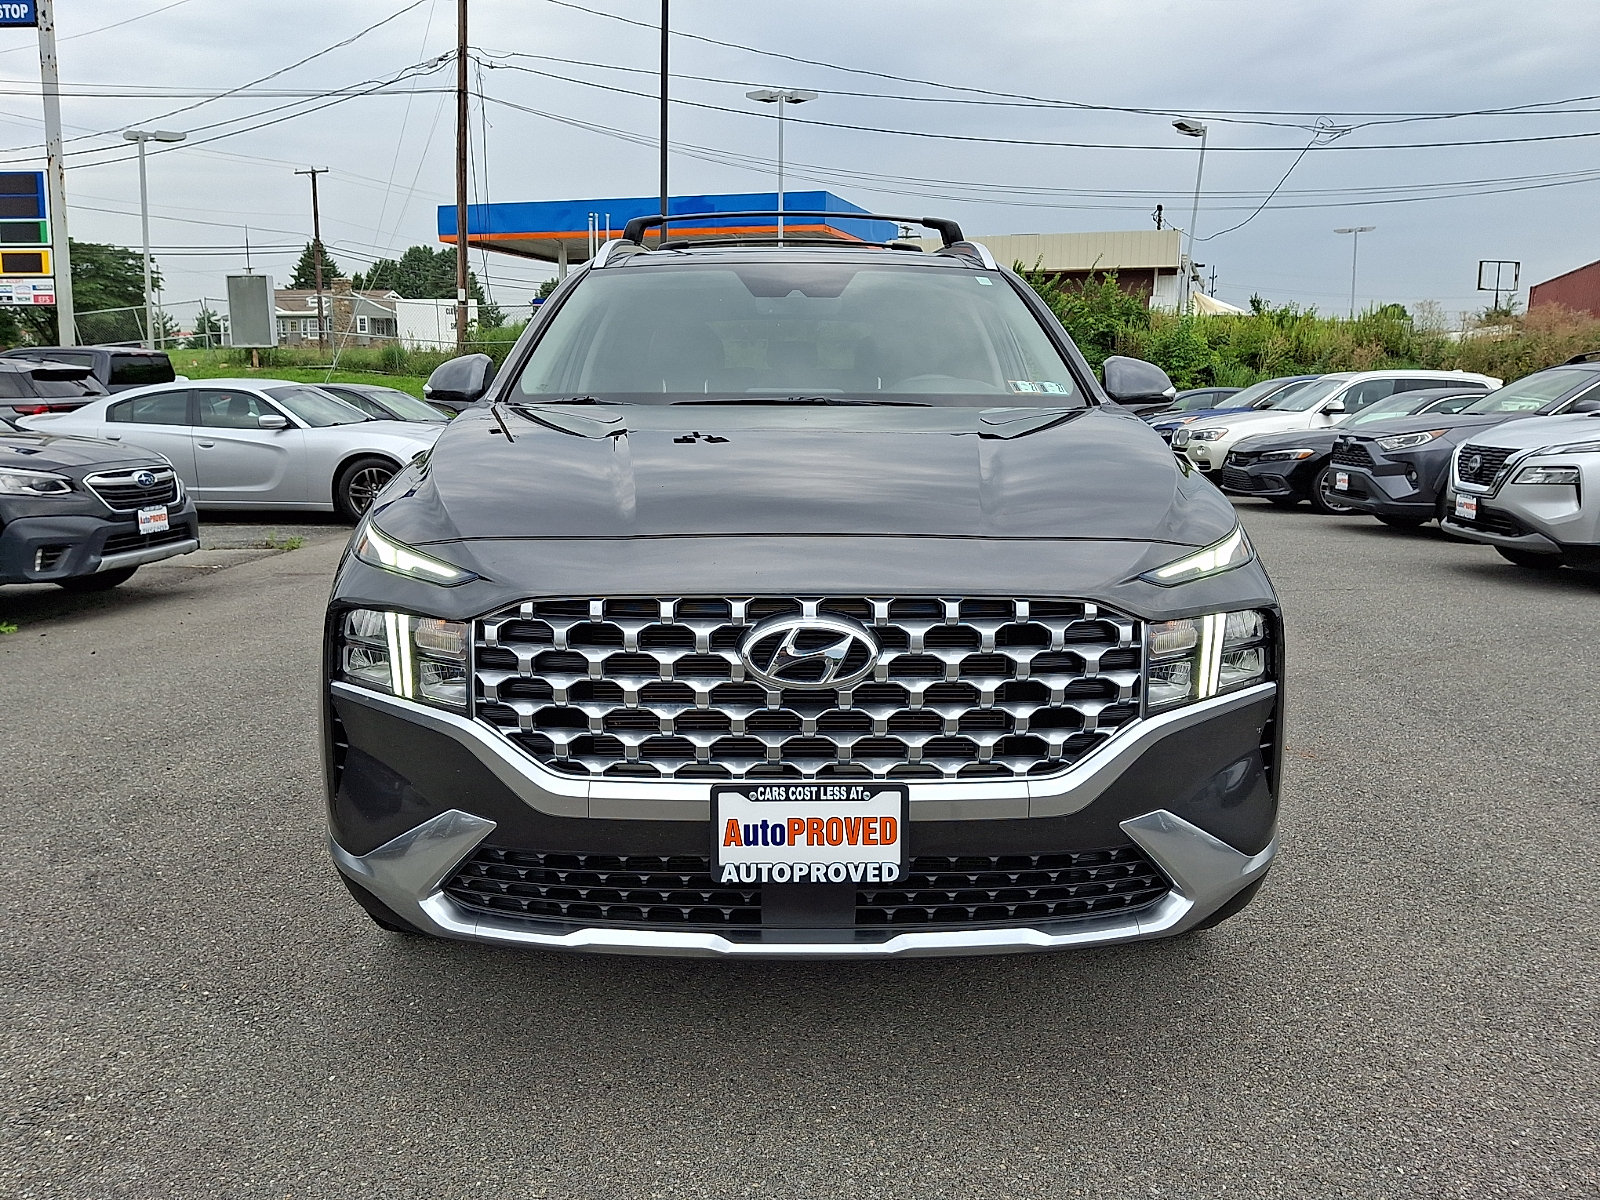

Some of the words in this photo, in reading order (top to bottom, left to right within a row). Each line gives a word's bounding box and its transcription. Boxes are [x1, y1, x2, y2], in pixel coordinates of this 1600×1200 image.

[757, 786, 786, 800] CARS
[788, 786, 818, 800] COST
[820, 786, 847, 800] LESS
[849, 786, 864, 800] AT
[723, 816, 898, 847] AutoPROVED
[720, 862, 900, 883] AUTOPROVED
